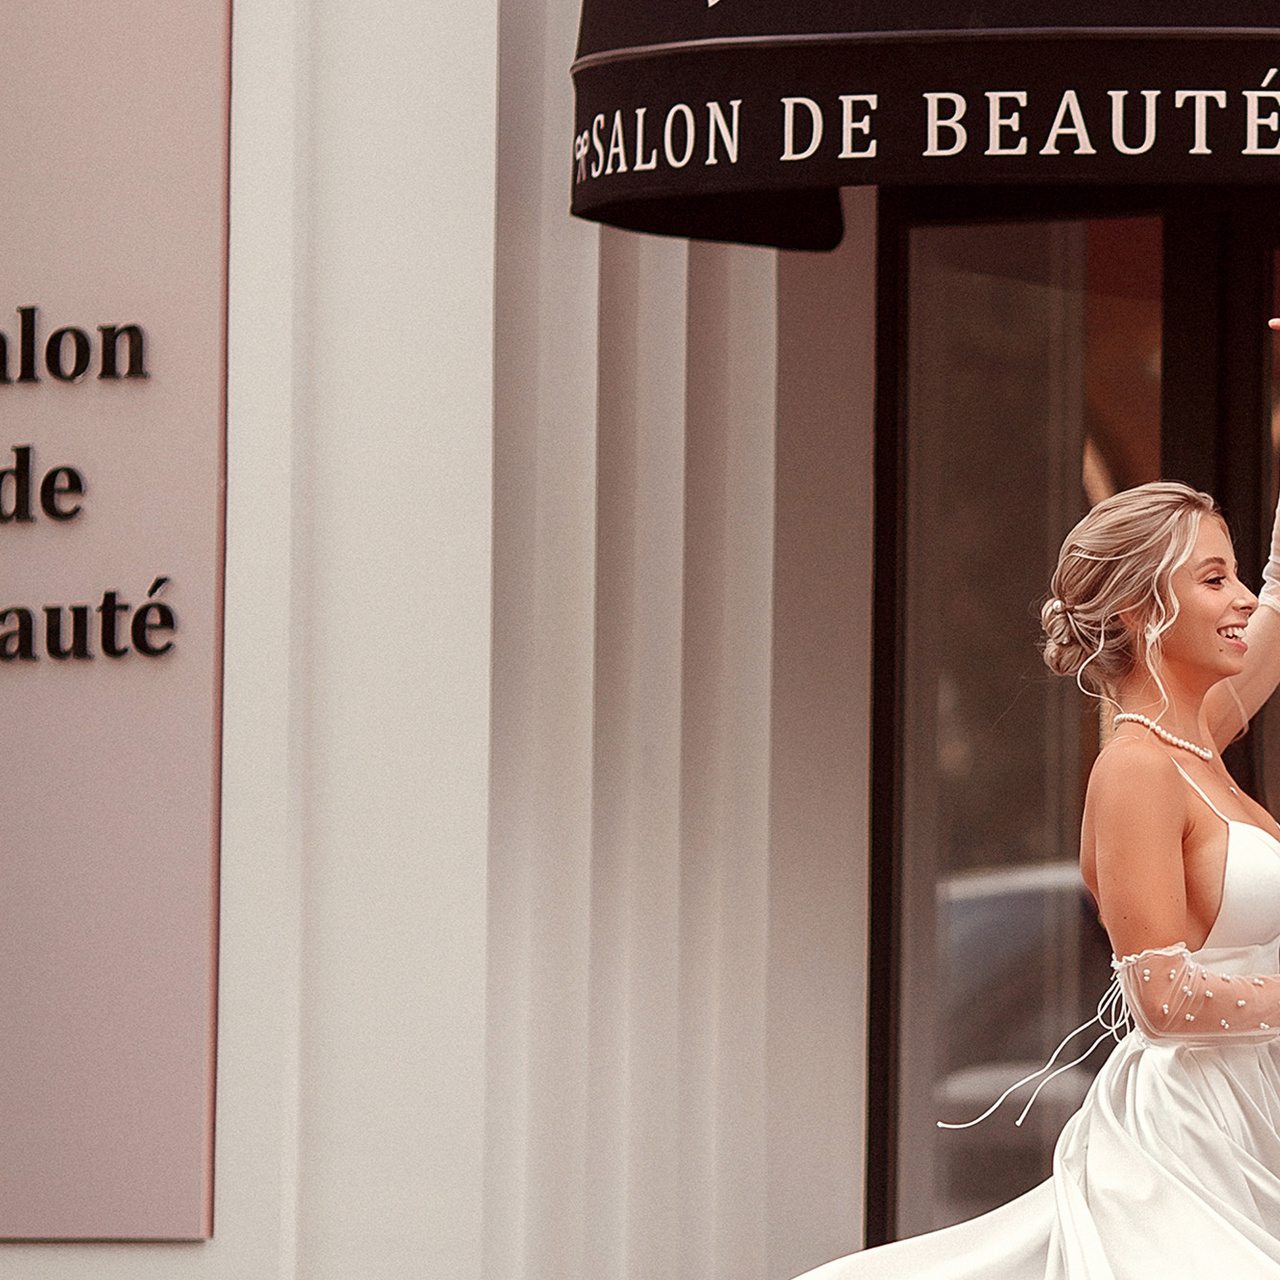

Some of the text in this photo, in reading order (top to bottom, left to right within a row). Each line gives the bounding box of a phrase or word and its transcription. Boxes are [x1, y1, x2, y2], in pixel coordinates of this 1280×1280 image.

[590, 99, 742, 178] SALON
[779, 94, 878, 161] DE
[0, 306, 150, 384] lon
